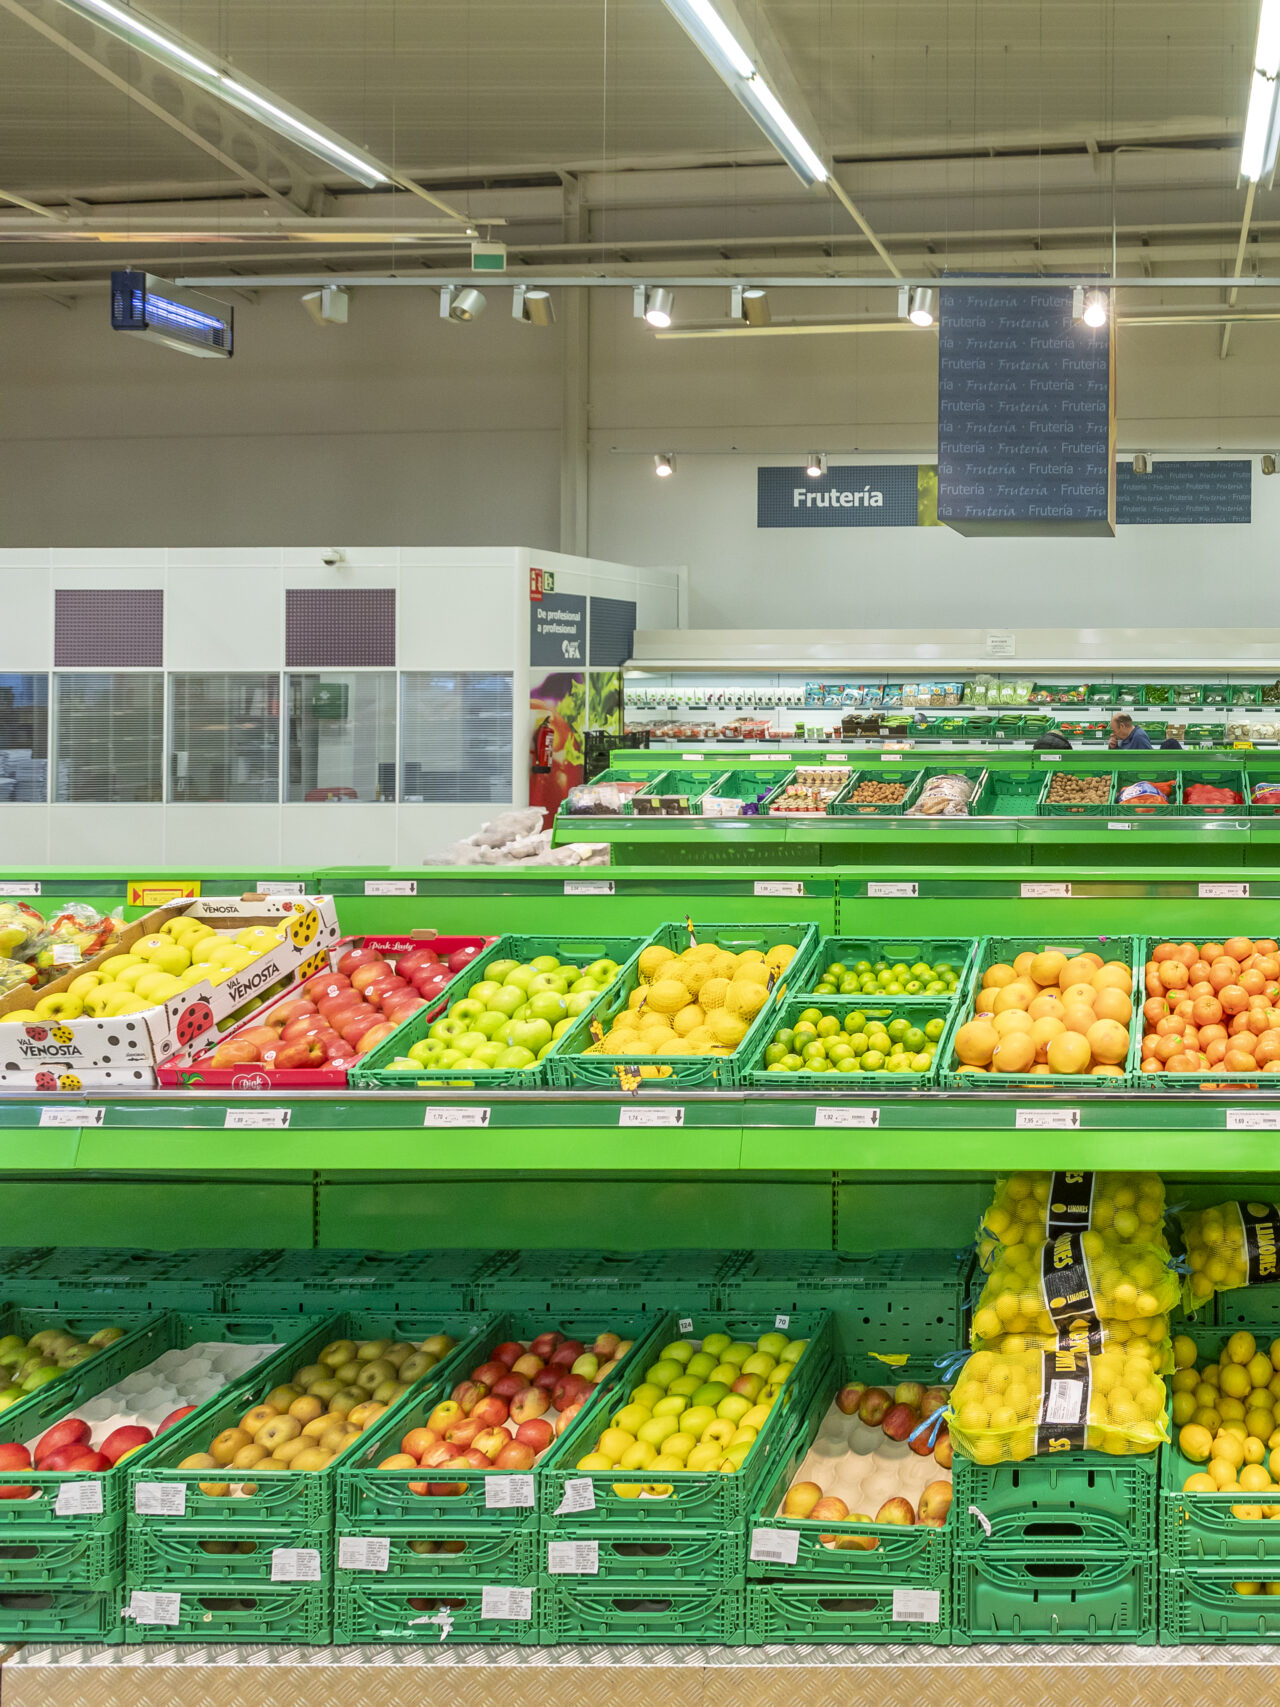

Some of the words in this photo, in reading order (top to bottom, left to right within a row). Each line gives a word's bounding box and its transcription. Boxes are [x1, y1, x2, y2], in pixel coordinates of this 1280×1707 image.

[965, 420, 1016, 433] Frutería
[1029, 420, 1074, 433] Frutería
[940, 441, 985, 453] Frutería
[997, 441, 1049, 454] Frutería
[1061, 441, 1106, 453] Frutería
[965, 462, 1016, 475] Frutería
[1029, 462, 1074, 474] Frutería
[793, 485, 884, 507] Frutería
[940, 483, 985, 495] Frutería
[997, 483, 1049, 497] Frutería
[1061, 483, 1105, 495] Frutería
[964, 504, 1016, 517] Frutería
[1029, 504, 1073, 516] Frutería
[537, 608, 547, 619] De
[547, 609, 581, 621] profesional
[537, 623, 542, 633] a
[542, 622, 577, 635] profesional
[202, 906, 240, 914] VENOSTA
[368, 941, 391, 951] Pink
[391, 941, 416, 952] Lady
[226, 977, 241, 990] VAL
[228, 962, 280, 1002] VENOSTA
[17, 1038, 34, 1047] VAL
[19, 1044, 82, 1057] VENOSTA
[1255, 1222, 1277, 1276] LIMONES
[1066, 1289, 1089, 1304] LIMONES
